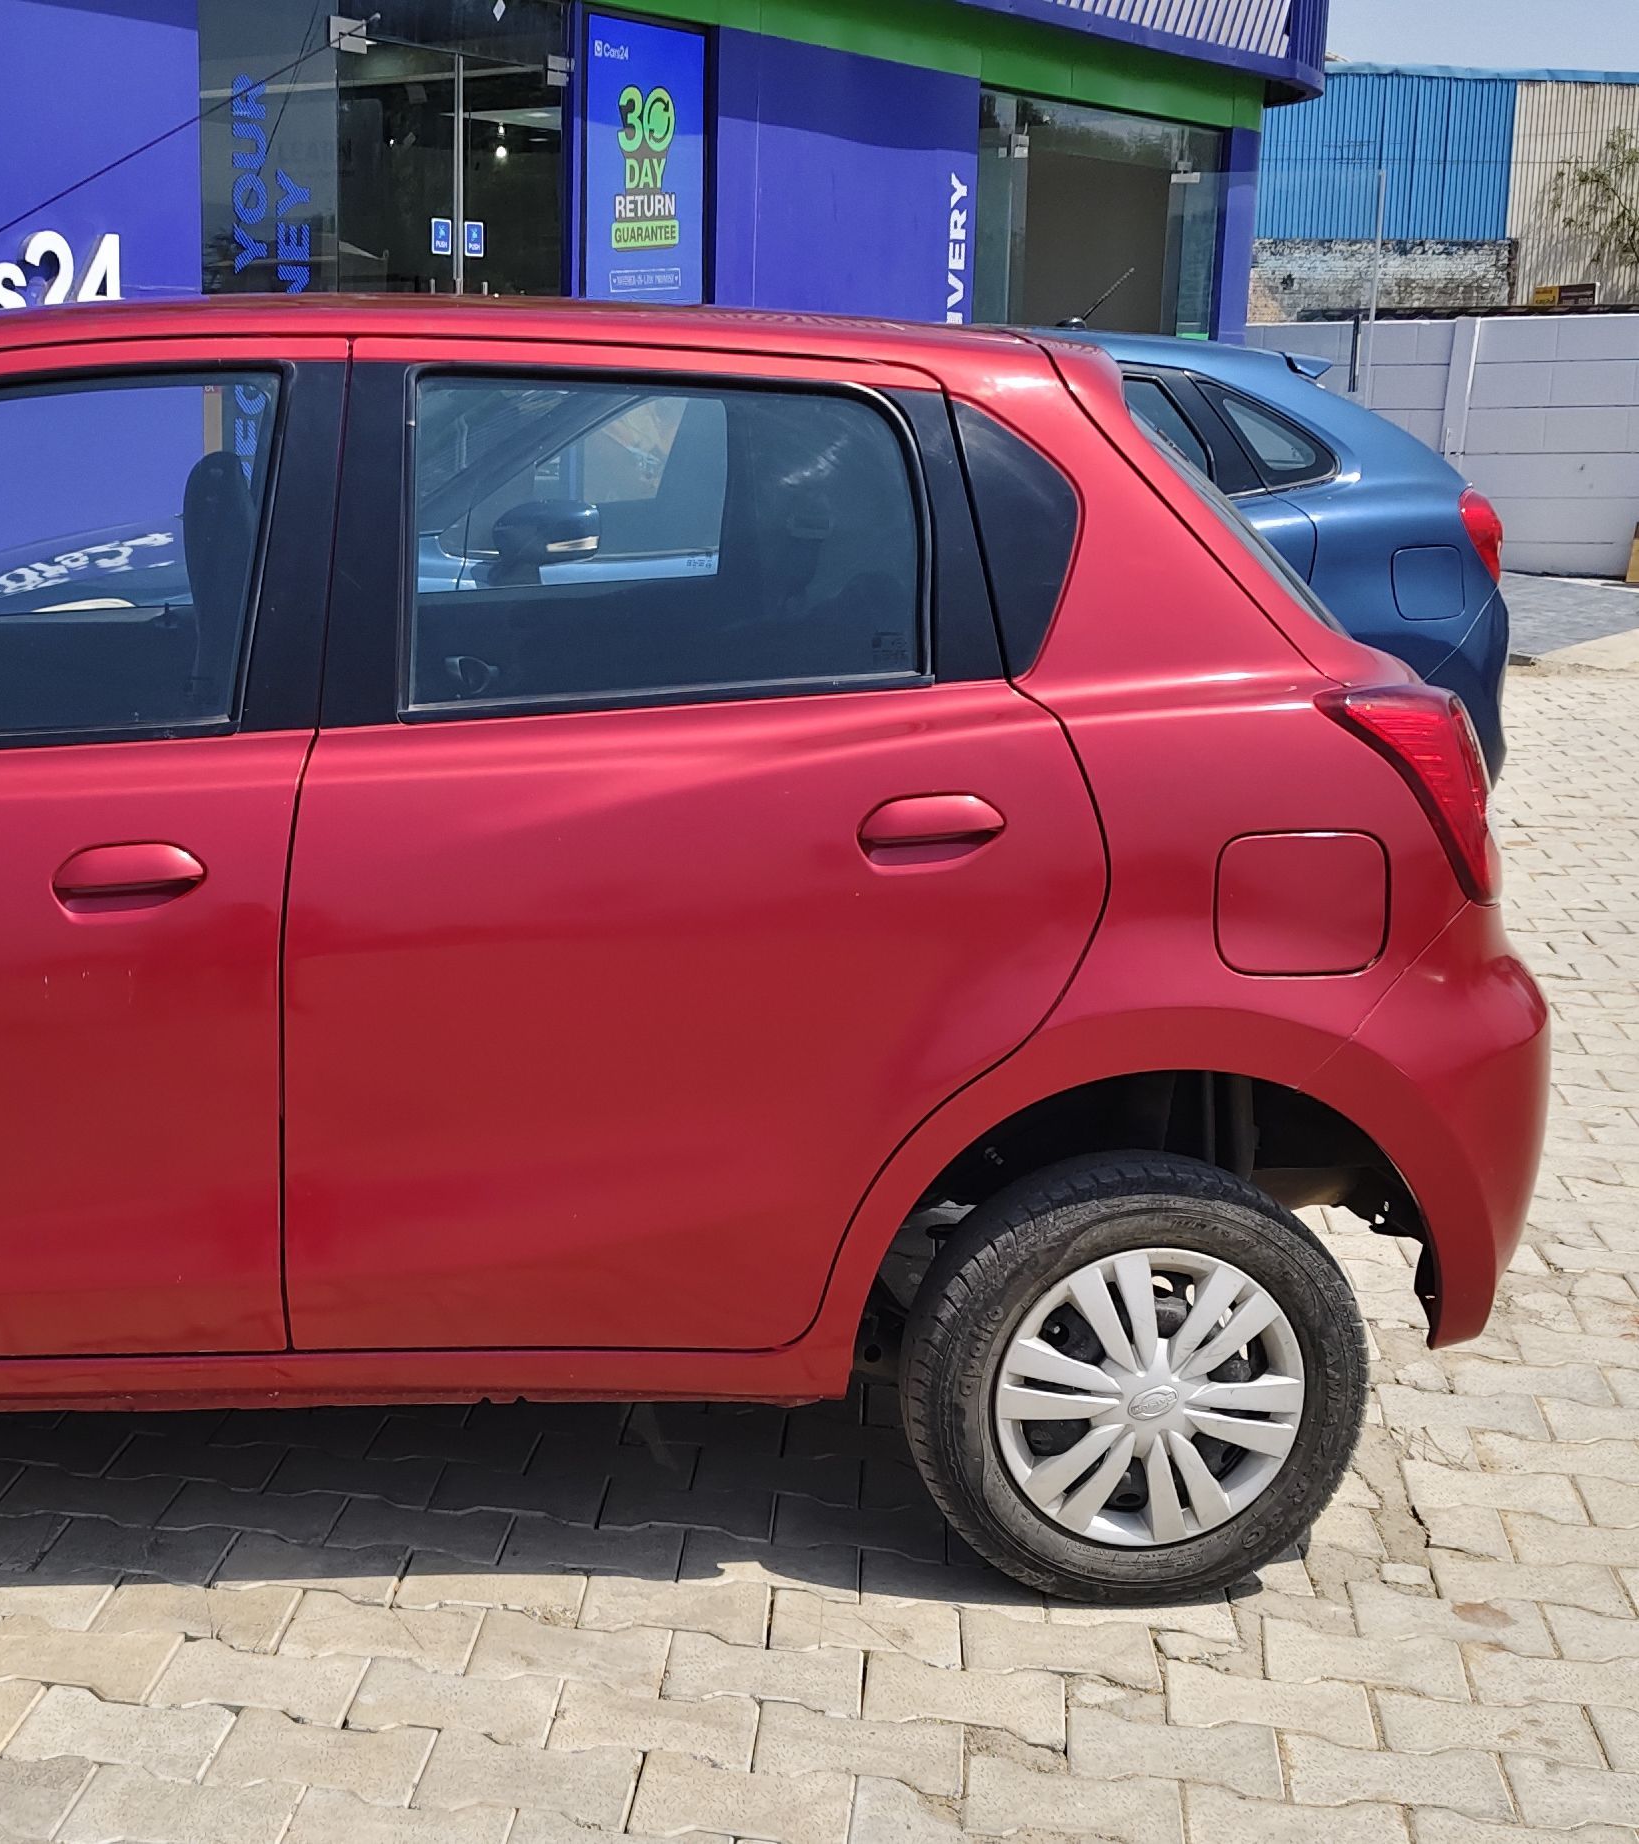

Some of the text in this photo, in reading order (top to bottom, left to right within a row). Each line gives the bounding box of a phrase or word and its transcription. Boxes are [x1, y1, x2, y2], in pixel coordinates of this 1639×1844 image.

[603, 42, 629, 60] Cars24
[617, 84, 675, 153] 30
[232, 73, 268, 275] YOUR
[625, 157, 667, 189] DAY
[614, 192, 676, 219] RETURN
[614, 223, 677, 245] GUARANTEE
